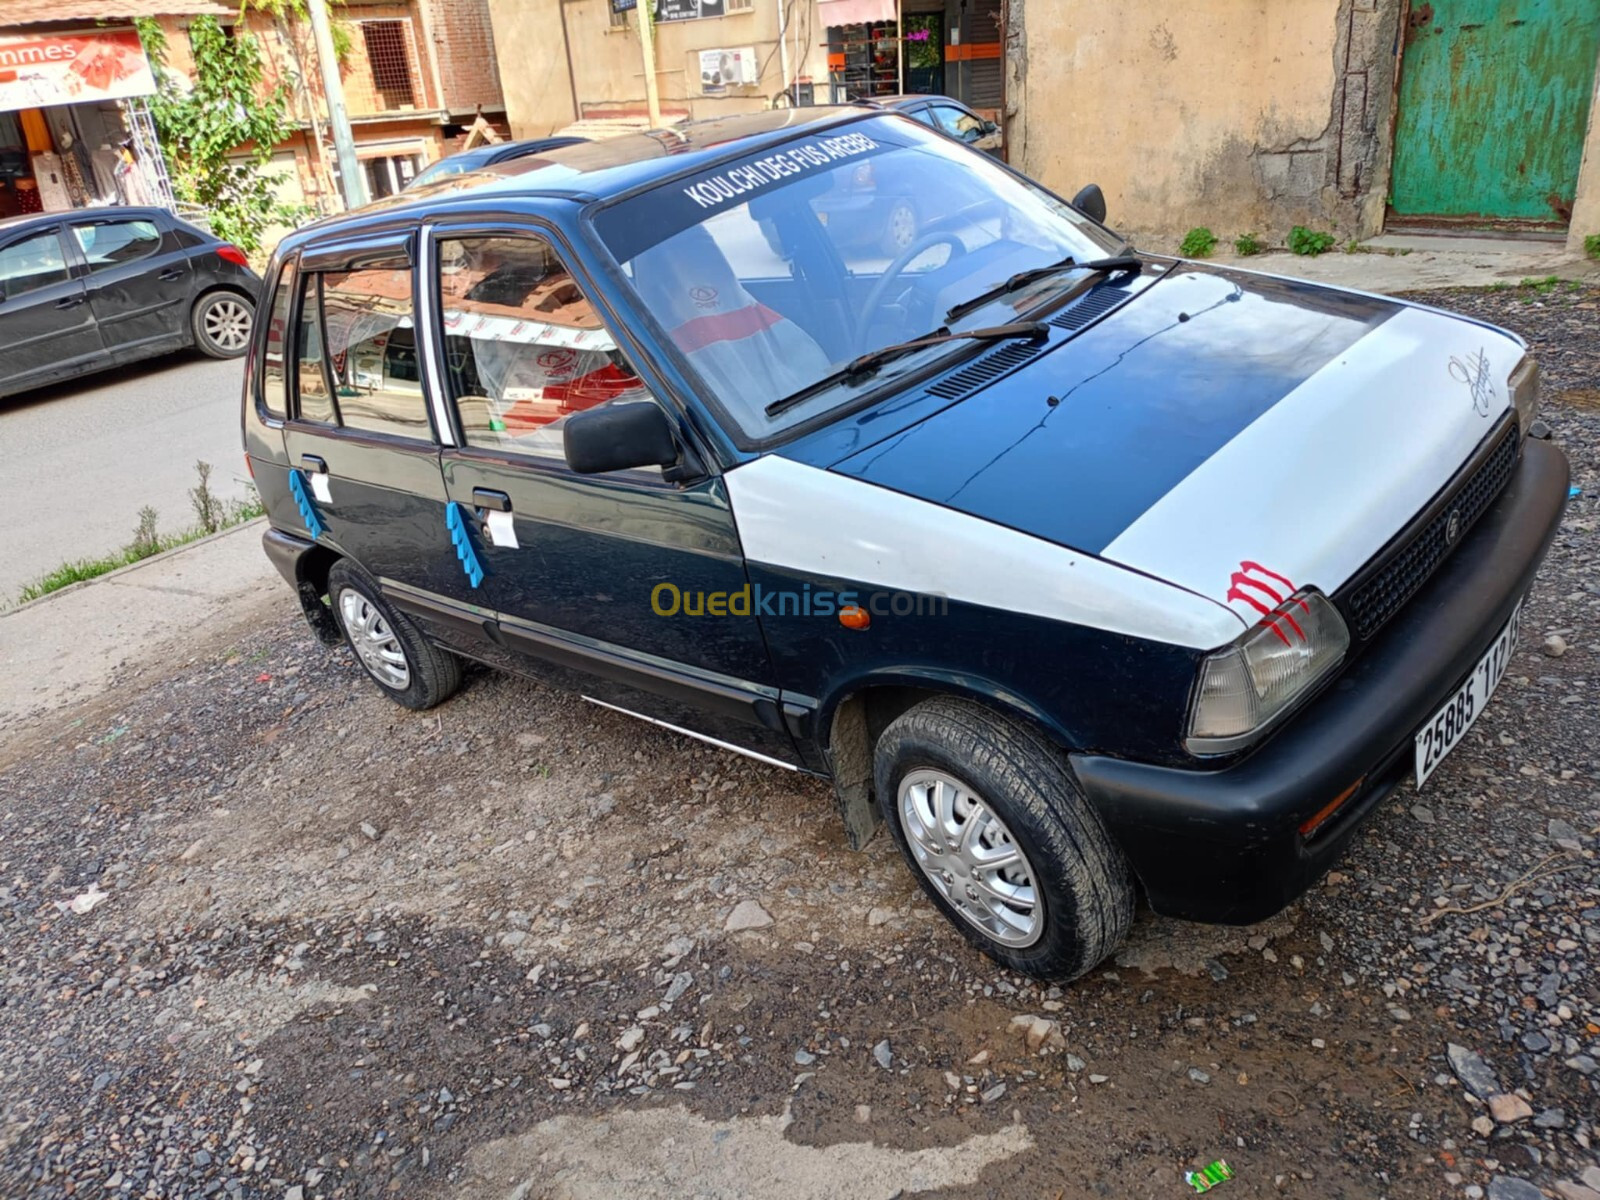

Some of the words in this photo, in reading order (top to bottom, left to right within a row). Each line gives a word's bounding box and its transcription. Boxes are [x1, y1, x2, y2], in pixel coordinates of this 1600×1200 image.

[683, 162, 770, 208] KOULCHI
[754, 154, 801, 180] DEG
[785, 144, 832, 169] FUS
[815, 132, 879, 159] AREBBI
[1423, 677, 1474, 774] 25885
[1483, 636, 1506, 699] 112
